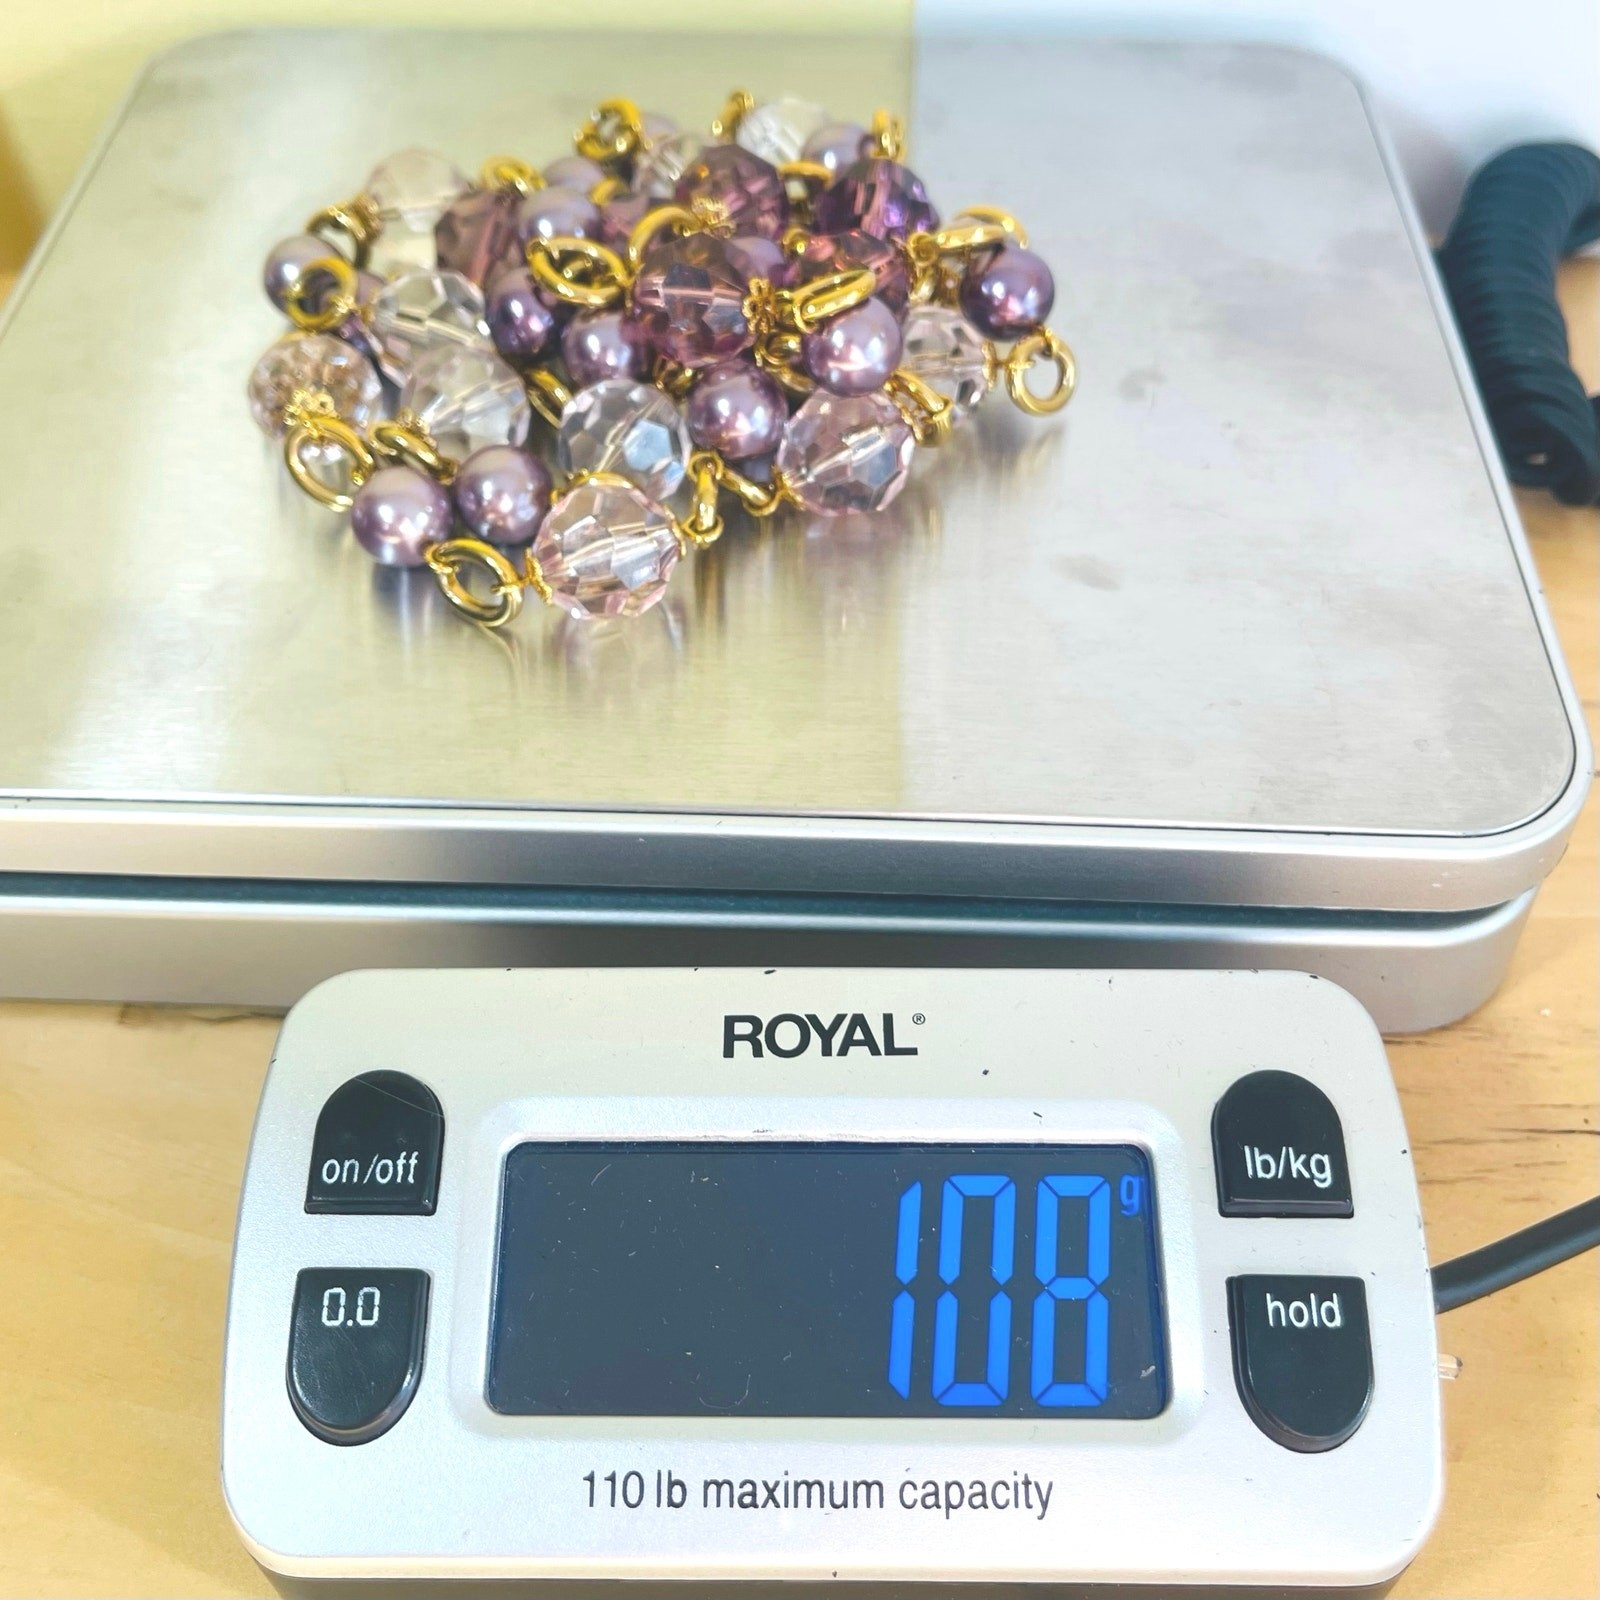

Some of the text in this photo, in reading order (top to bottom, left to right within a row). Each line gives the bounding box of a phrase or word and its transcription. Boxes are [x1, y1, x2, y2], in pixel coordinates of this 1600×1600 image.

[320, 1150, 420, 1186] on/off
[1243, 1145, 1333, 1189] lb/kg
[320, 1286, 382, 1329] 0.0
[887, 1173, 1145, 1407] 108 g
[1265, 1292, 1342, 1329] hold
[582, 1471, 1054, 1520] 110 lb maximum capacity
